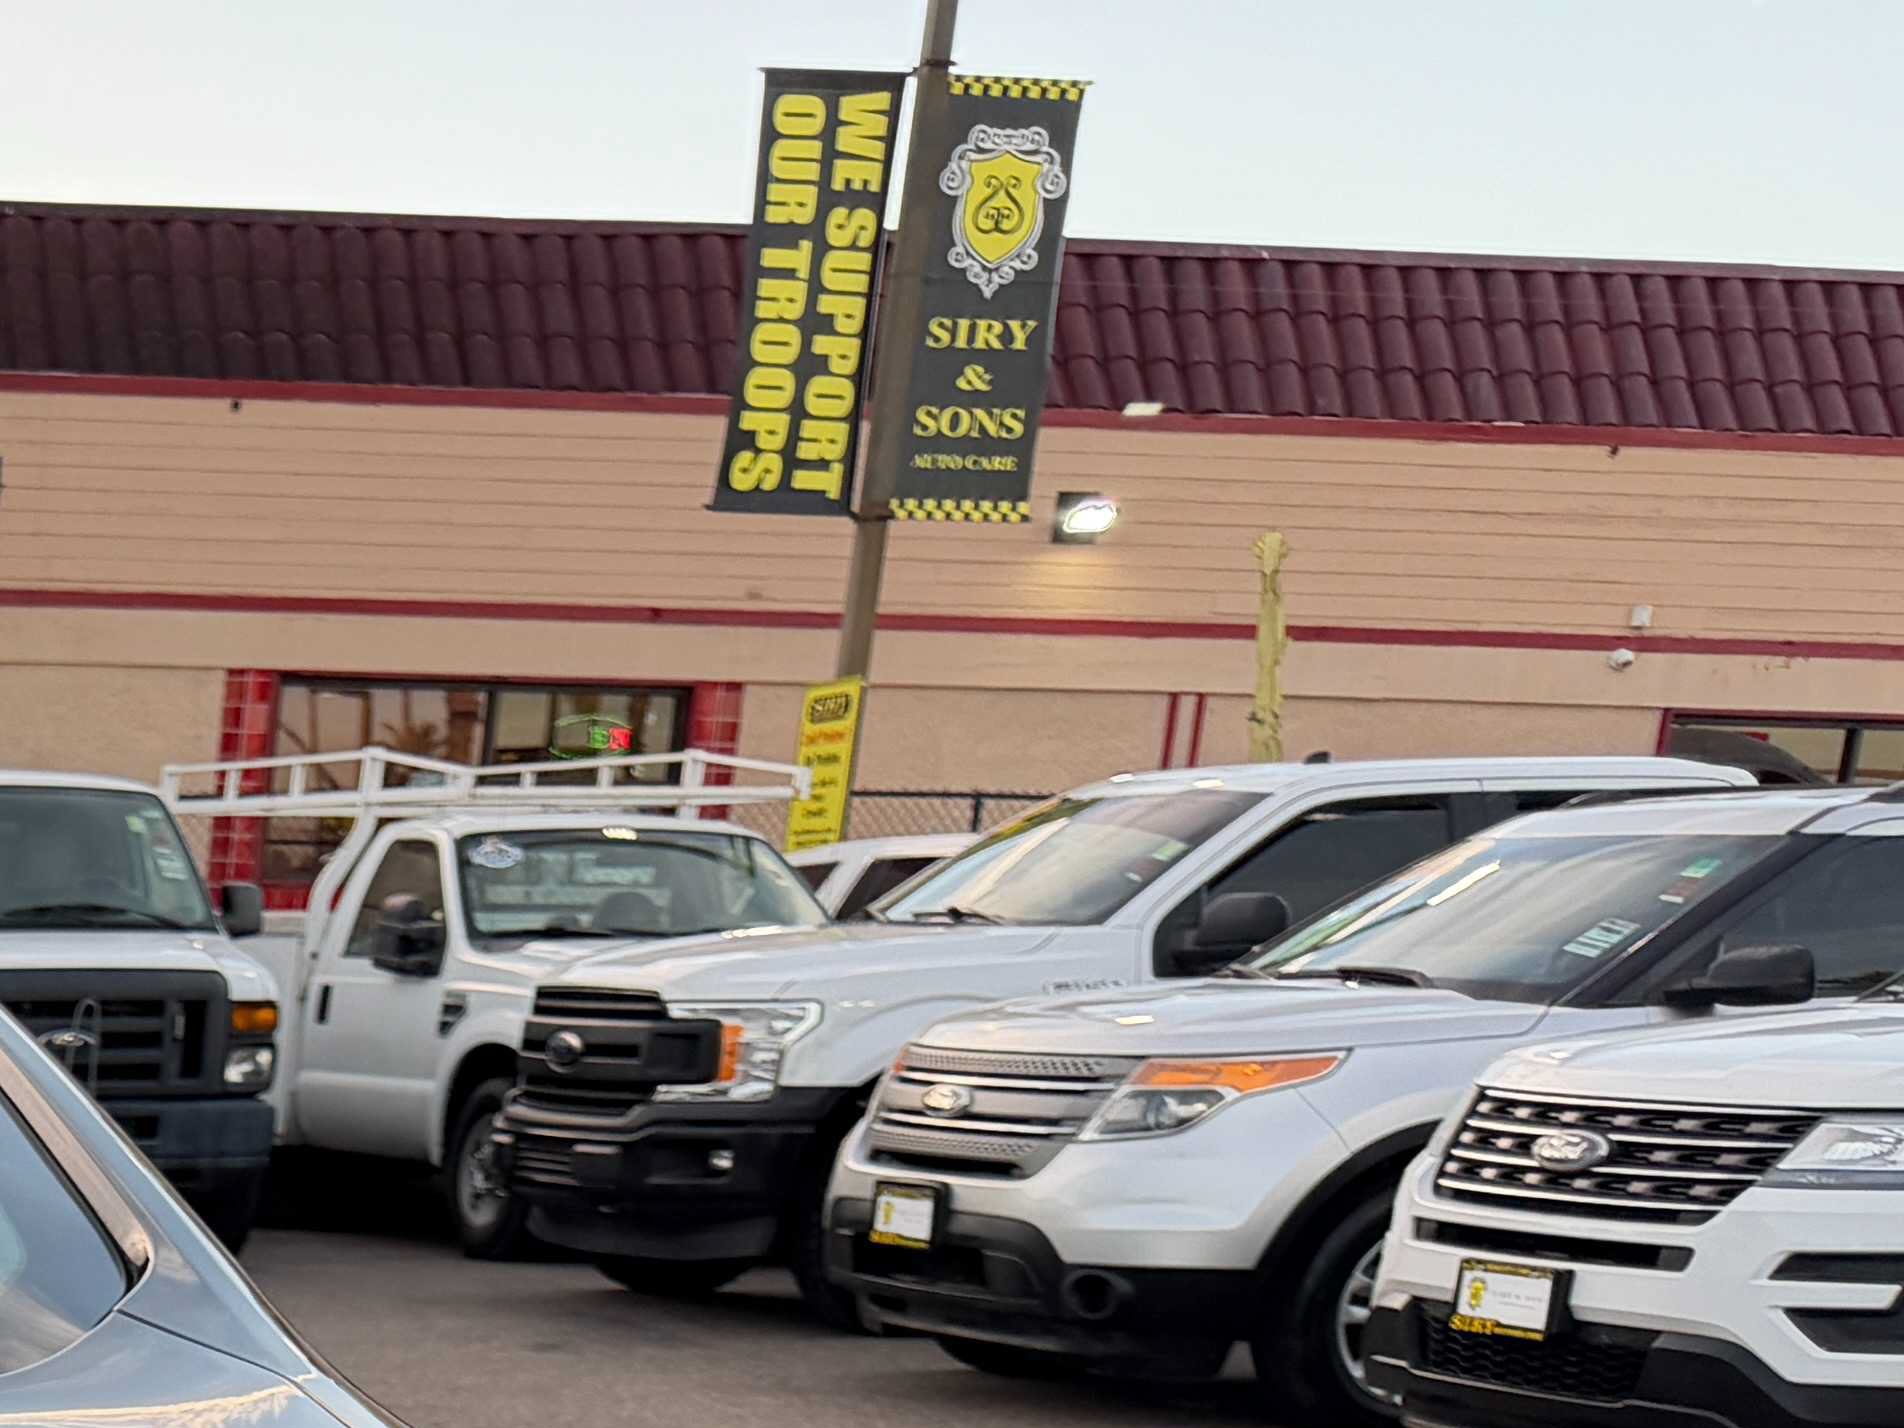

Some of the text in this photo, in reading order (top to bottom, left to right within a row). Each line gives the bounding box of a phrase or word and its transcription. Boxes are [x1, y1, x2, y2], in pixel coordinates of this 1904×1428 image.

[728, 93, 826, 492] OUR TROOPS
[790, 90, 892, 500] WE SUPPORT
[925, 316, 1040, 350] SIRY
[955, 364, 995, 392] &
[913, 404, 1026, 440] SONS
